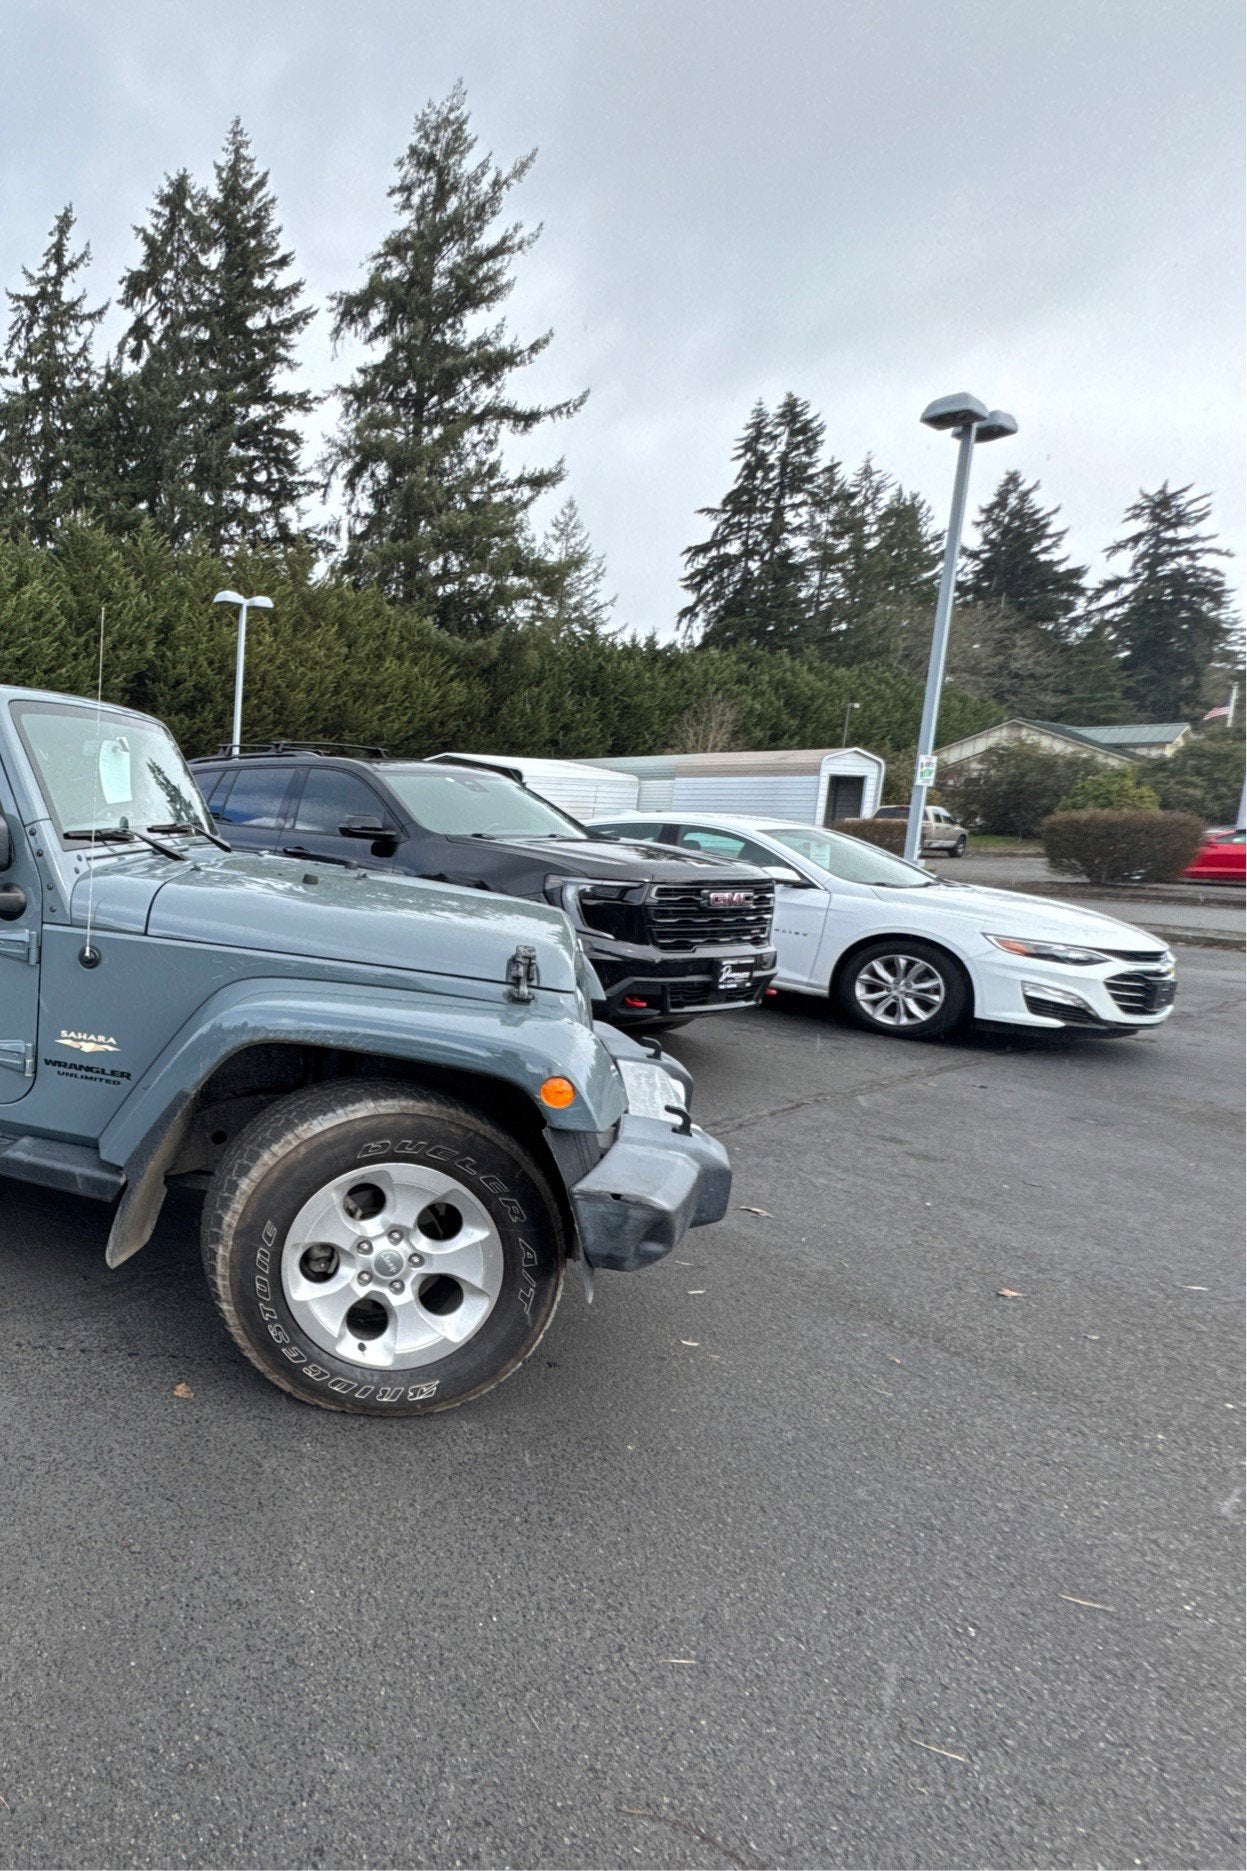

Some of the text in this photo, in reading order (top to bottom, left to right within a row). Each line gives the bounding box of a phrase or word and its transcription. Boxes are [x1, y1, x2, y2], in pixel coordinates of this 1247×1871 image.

[709, 892, 754, 906] GMC
[60, 1030, 117, 1045] SAHARA
[43, 1058, 133, 1081] WRANGLER
[57, 1070, 122, 1086] UNLIMITED
[356, 1139, 538, 1315] DUELER A/T
[253, 1220, 441, 1402] BRIDGESTONE
